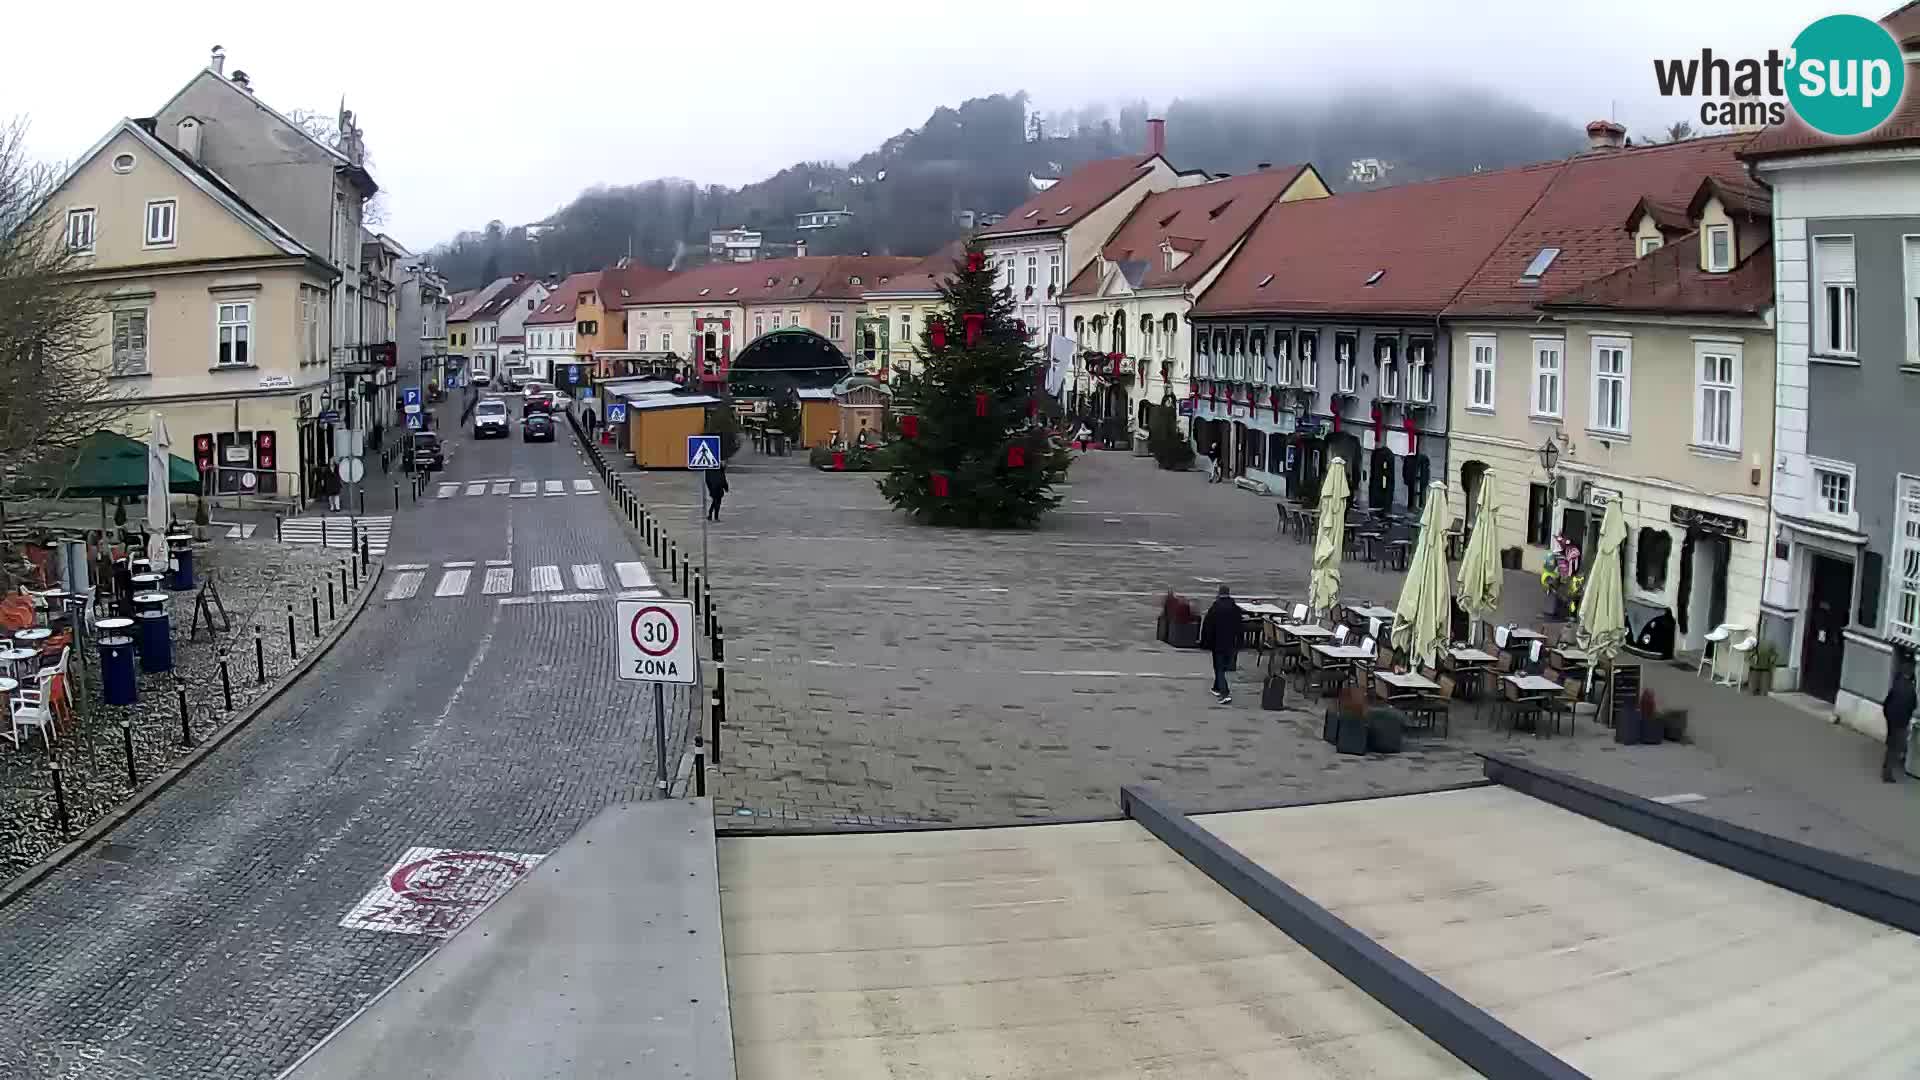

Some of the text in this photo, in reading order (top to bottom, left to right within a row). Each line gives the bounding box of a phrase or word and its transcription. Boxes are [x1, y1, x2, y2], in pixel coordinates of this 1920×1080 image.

[408, 391, 416, 402] P
[644, 622, 667, 643] 30
[634, 660, 678, 677] ZONA
